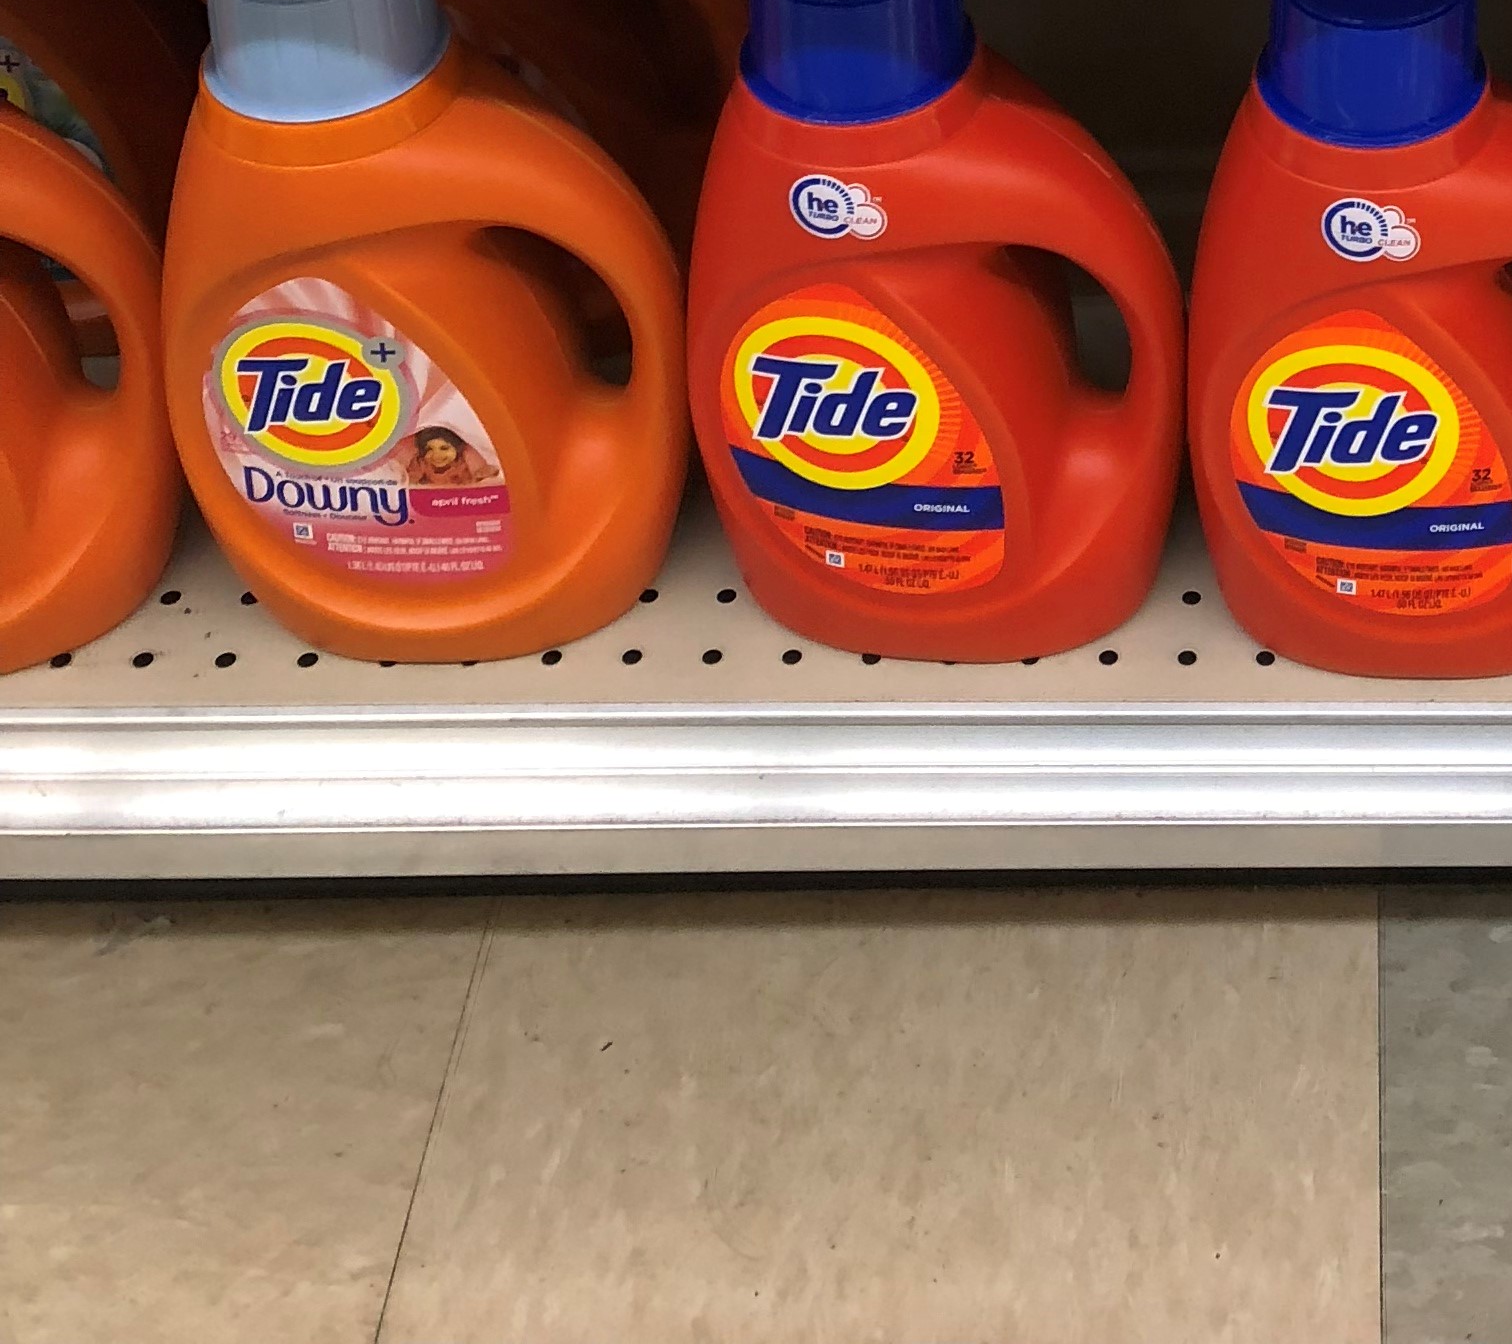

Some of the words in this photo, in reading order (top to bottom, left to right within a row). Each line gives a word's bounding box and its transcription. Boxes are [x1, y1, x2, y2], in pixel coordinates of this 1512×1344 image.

[808, 191, 838, 212] he
[1340, 215, 1372, 237] he
[235, 357, 383, 434] Tide
[751, 353, 919, 440] Tide
[1264, 387, 1439, 475] Tide
[953, 451, 975, 465] 32
[1471, 467, 1491, 482] 32
[243, 465, 409, 527] Downy
[431, 496, 459, 508] april
[913, 503, 971, 513] ORIGINAL
[1429, 521, 1485, 533] ORIGINAL
